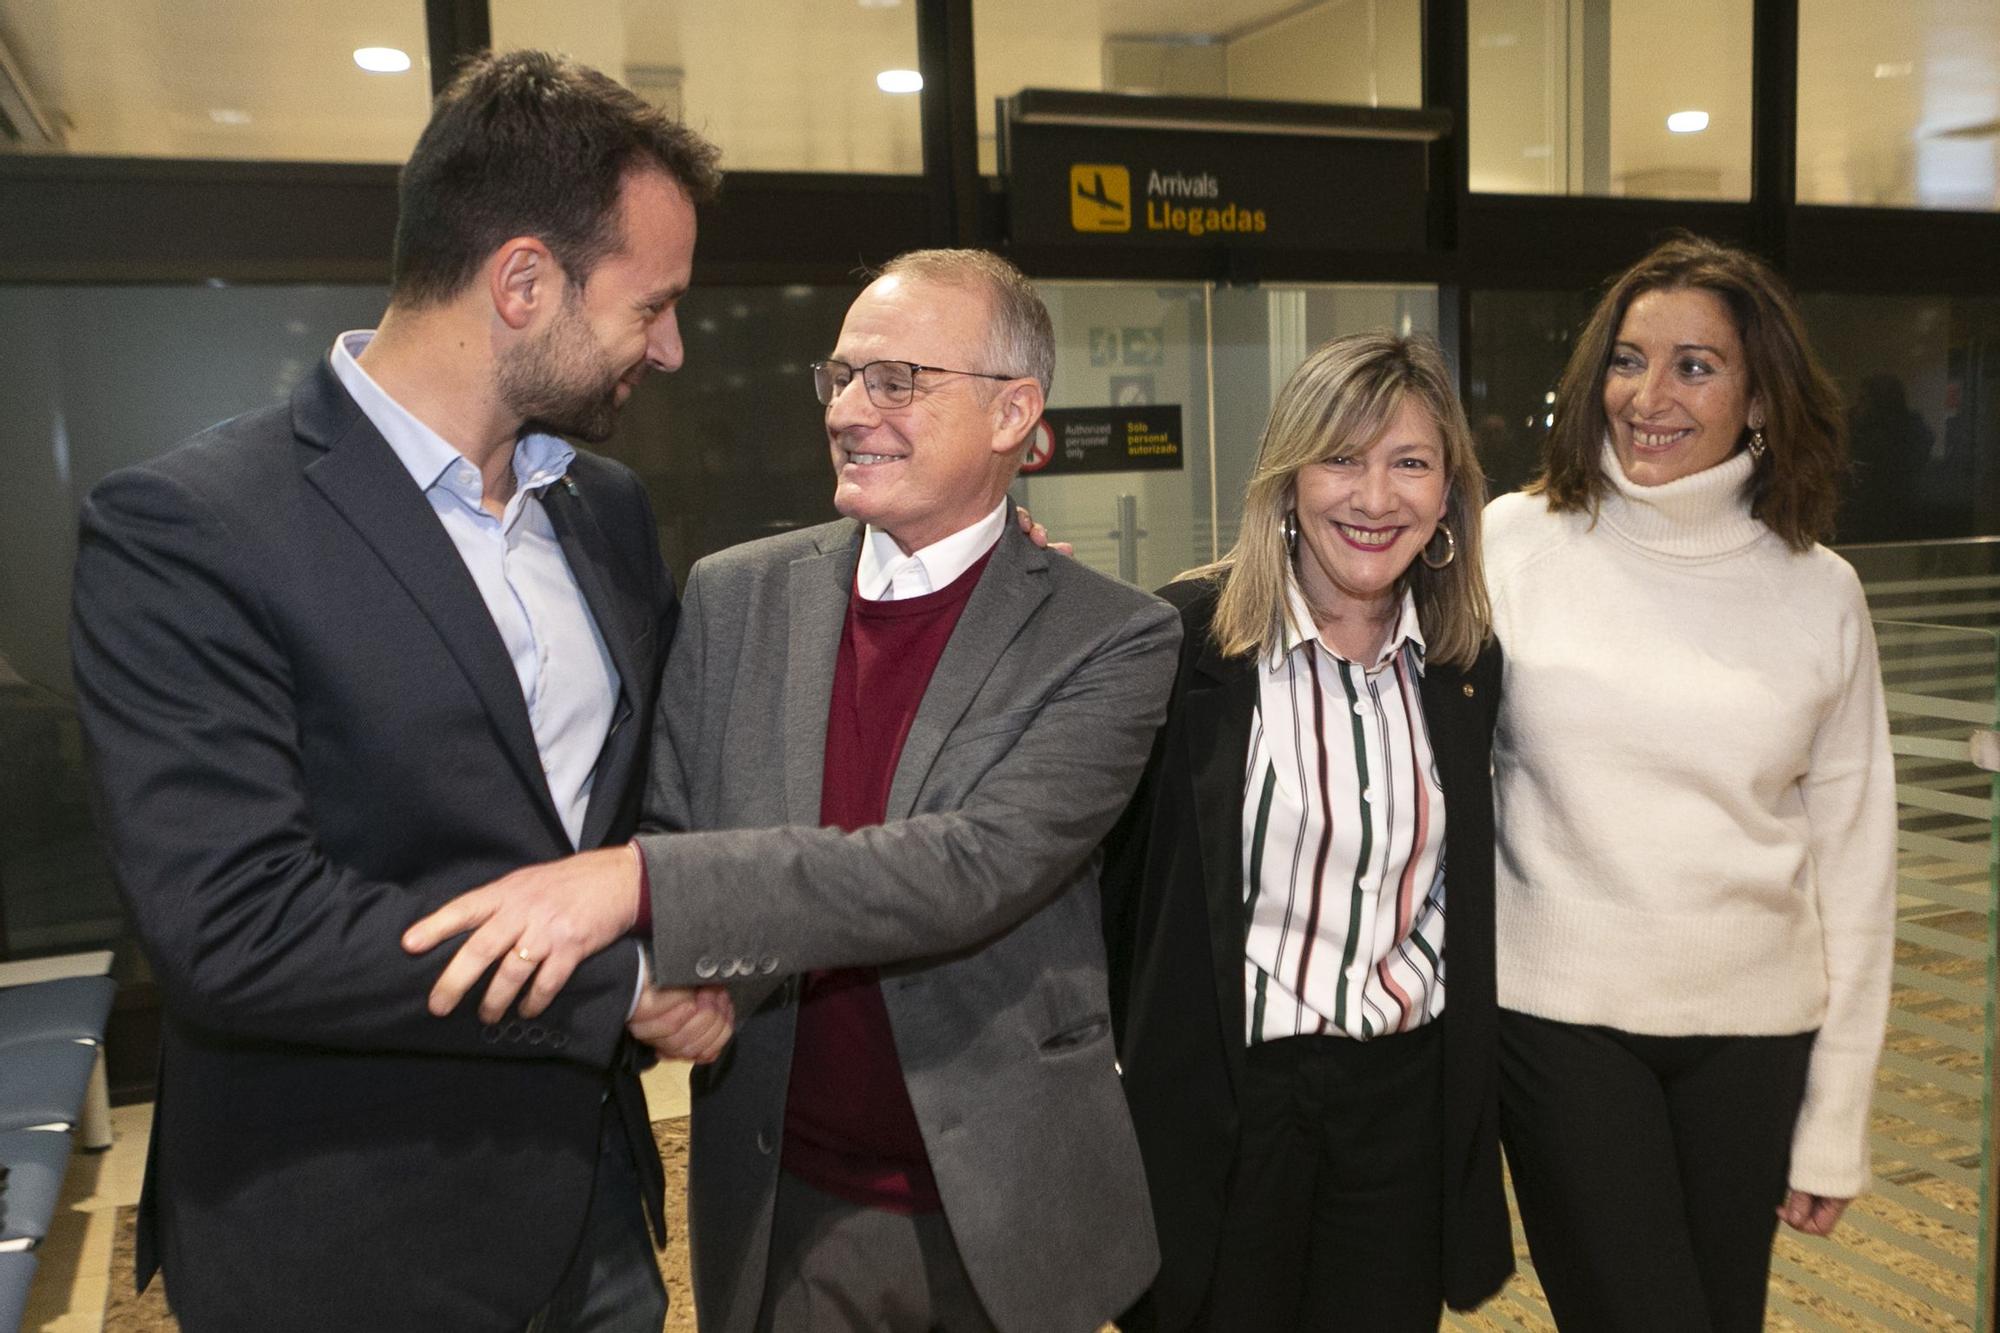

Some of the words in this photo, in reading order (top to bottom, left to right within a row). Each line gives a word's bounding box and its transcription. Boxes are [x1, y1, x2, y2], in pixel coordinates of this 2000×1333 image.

[1147, 169, 1219, 198] Arrivals
[1147, 200, 1267, 236] Llegadas
[1066, 436, 1109, 448] personnel
[1127, 433, 1169, 446] personal
[1066, 448, 1085, 459] only
[1127, 444, 1178, 456] autorizado
